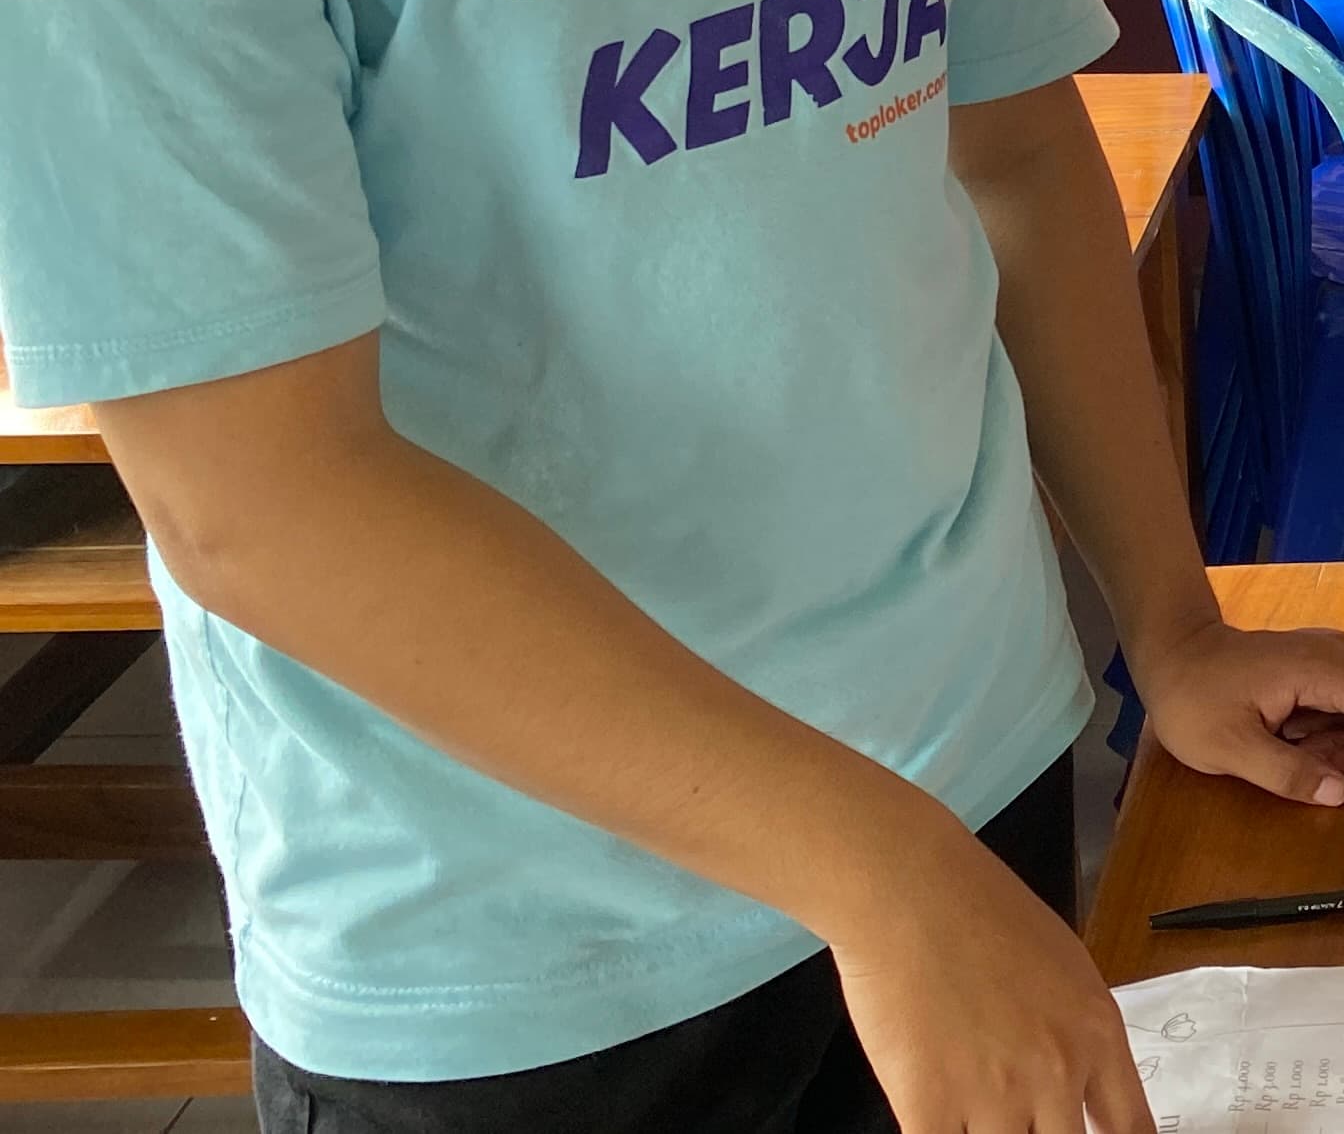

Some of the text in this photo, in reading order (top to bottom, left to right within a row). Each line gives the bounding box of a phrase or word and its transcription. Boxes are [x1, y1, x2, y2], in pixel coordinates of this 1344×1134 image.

[1254, 1061, 1280, 1112] Rp 3.000
[1228, 1095, 1252, 1112] Rp
[1282, 1093, 1306, 1110] Rp
[1309, 1090, 1333, 1107] Rp
